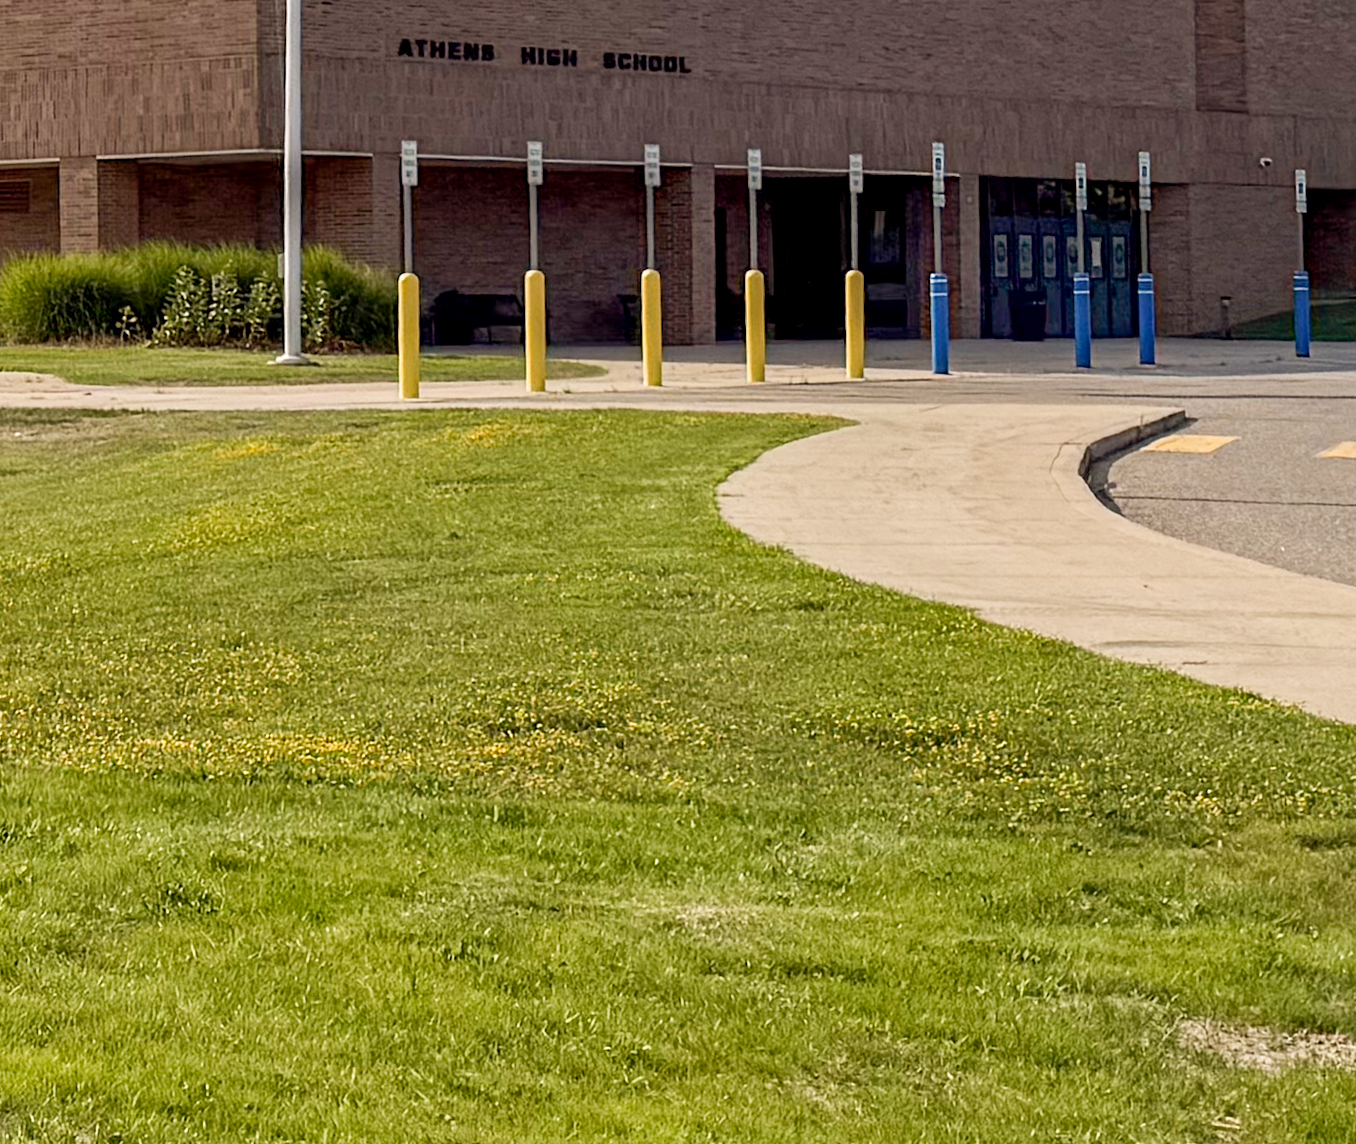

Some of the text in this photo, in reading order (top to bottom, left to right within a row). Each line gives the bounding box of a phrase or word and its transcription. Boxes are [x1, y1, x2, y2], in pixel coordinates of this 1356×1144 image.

[398, 38, 691, 74] ATHENS HIGH SCHOOL
